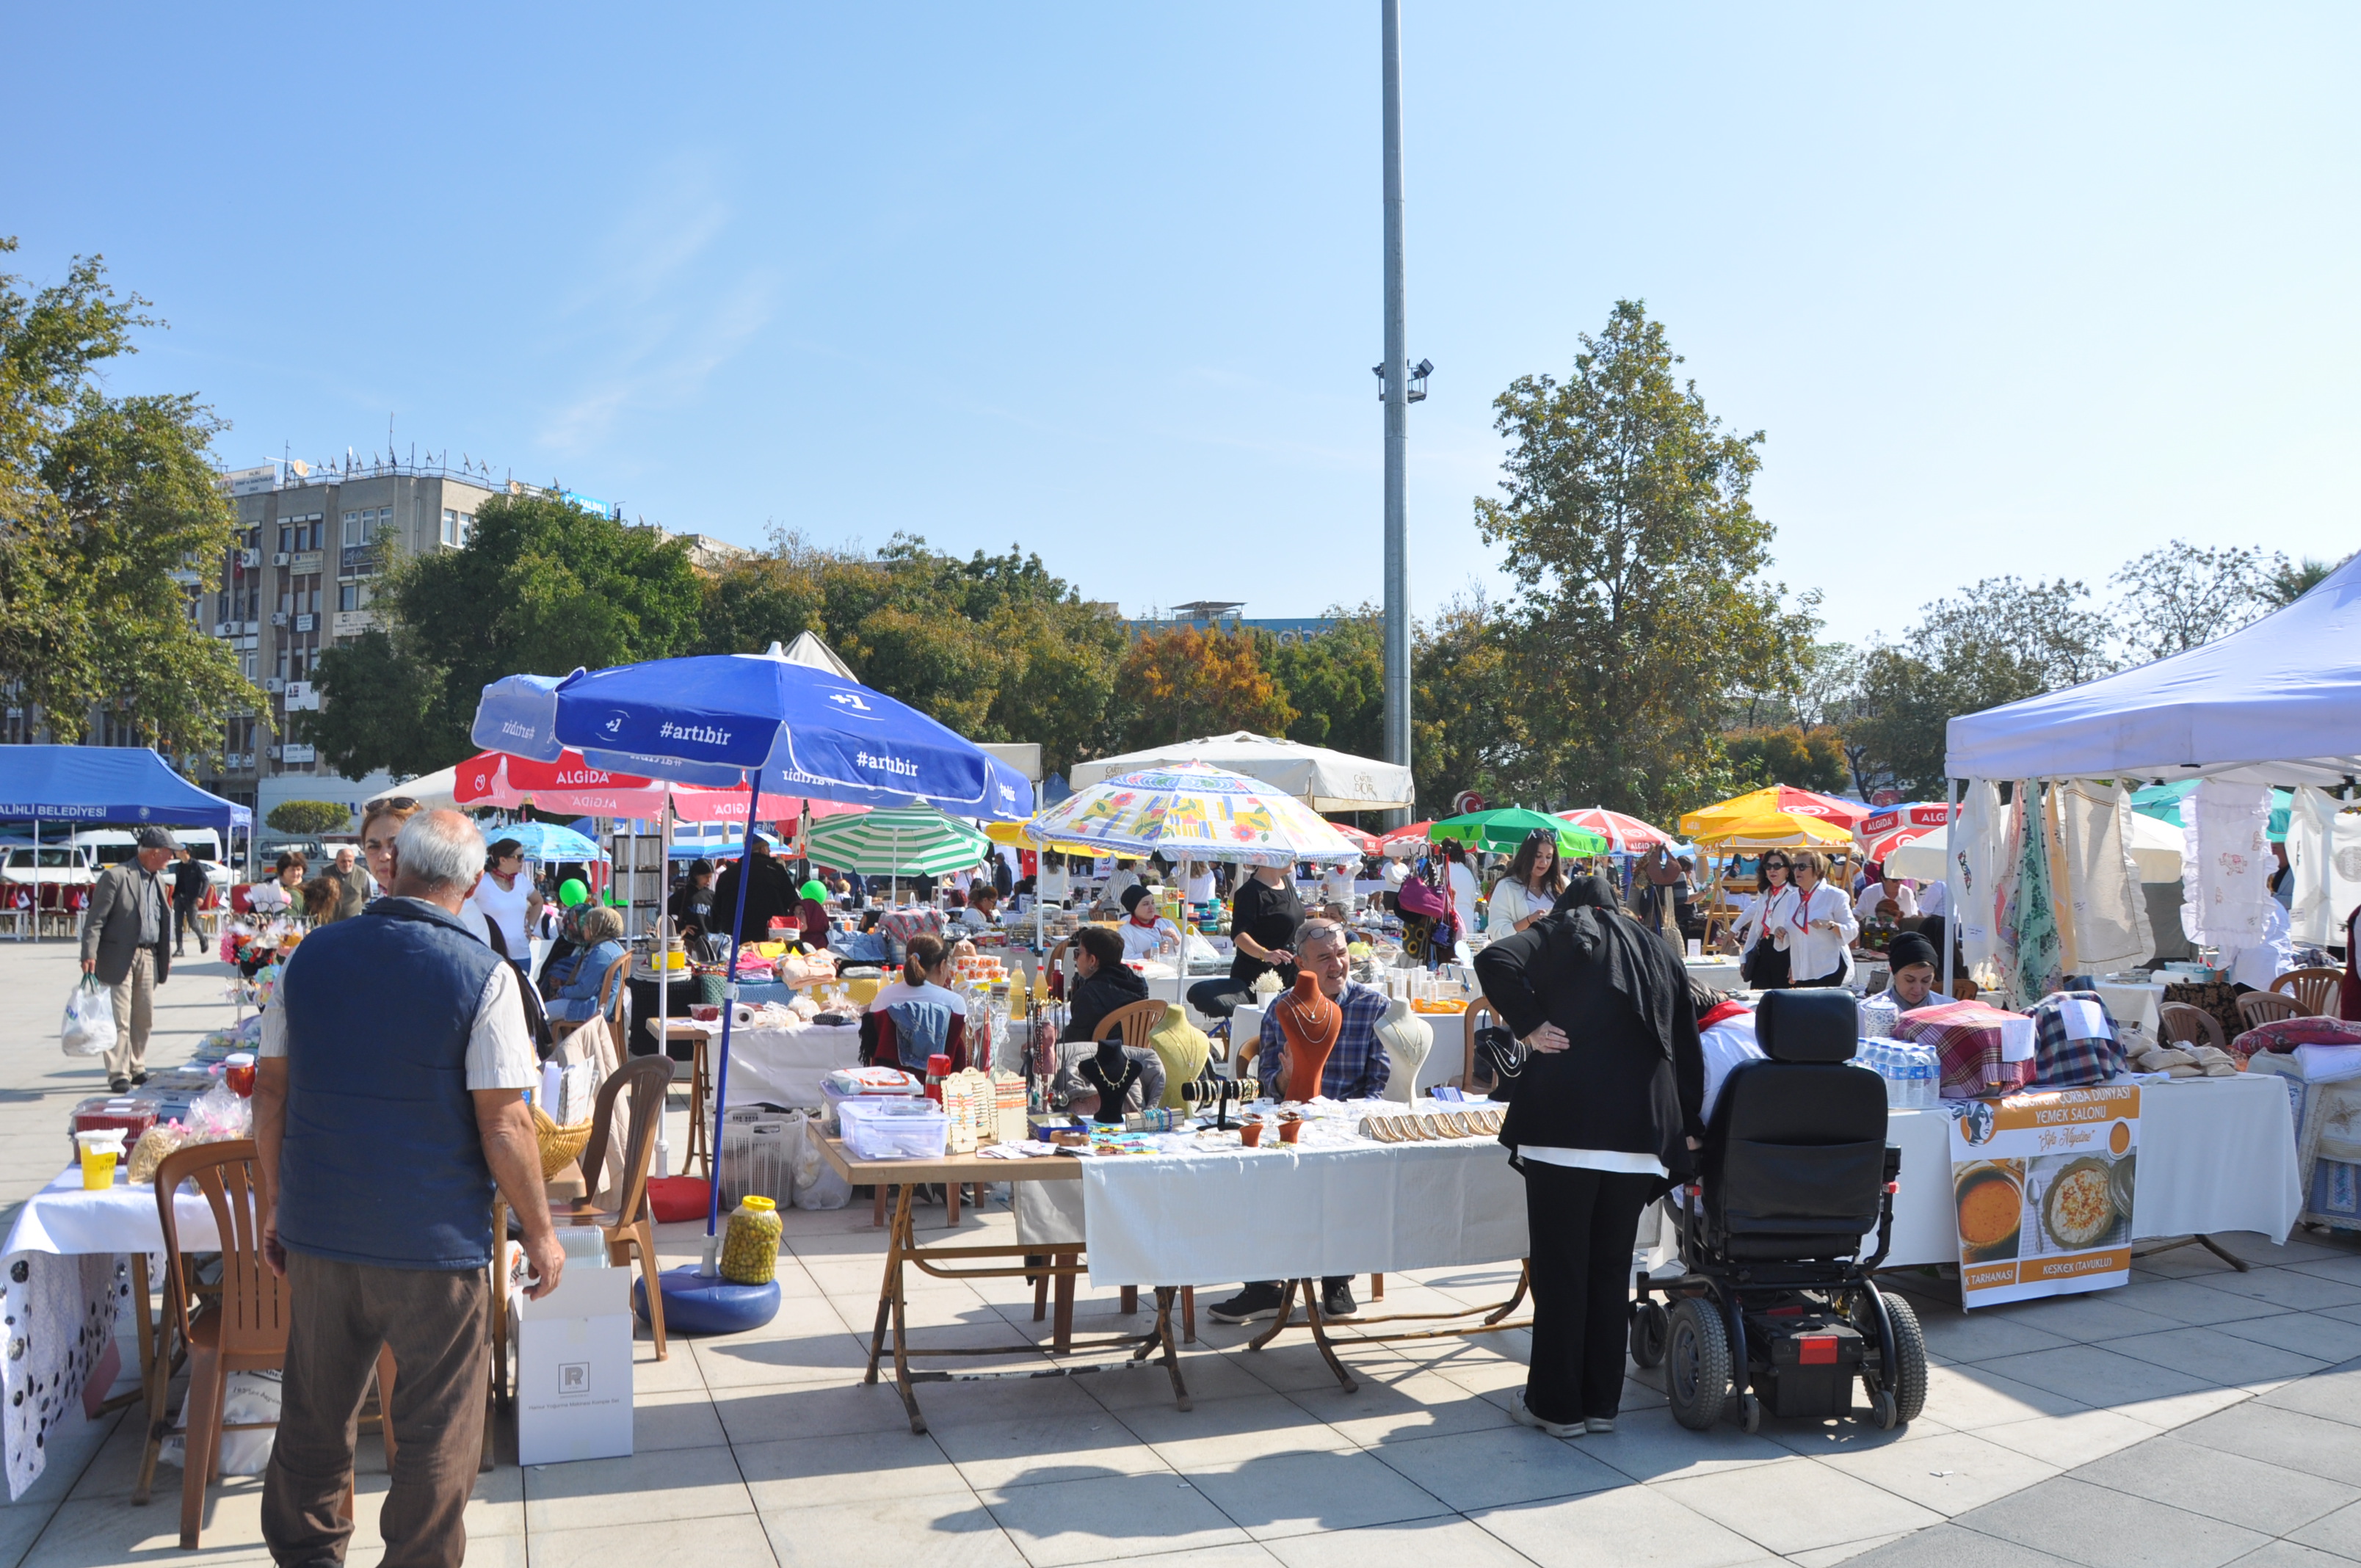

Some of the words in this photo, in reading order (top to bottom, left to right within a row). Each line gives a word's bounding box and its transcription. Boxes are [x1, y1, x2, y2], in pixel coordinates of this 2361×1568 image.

[579, 498, 607, 513] SALİHLİ
[829, 694, 871, 711] +1
[605, 717, 622, 733] +1
[660, 721, 731, 746] #artıbir
[856, 751, 918, 777] #artıbir
[37, 805, 107, 818] BELEDİYESİ
[2035, 1108, 2069, 1124] YEMEK
[2070, 1105, 2106, 1121] SALONU
[2042, 1263, 2074, 1276] KEŞKEK
[2075, 1257, 2112, 1273] (TAVUKLU)
[1970, 1270, 2013, 1285] TARHANASI
